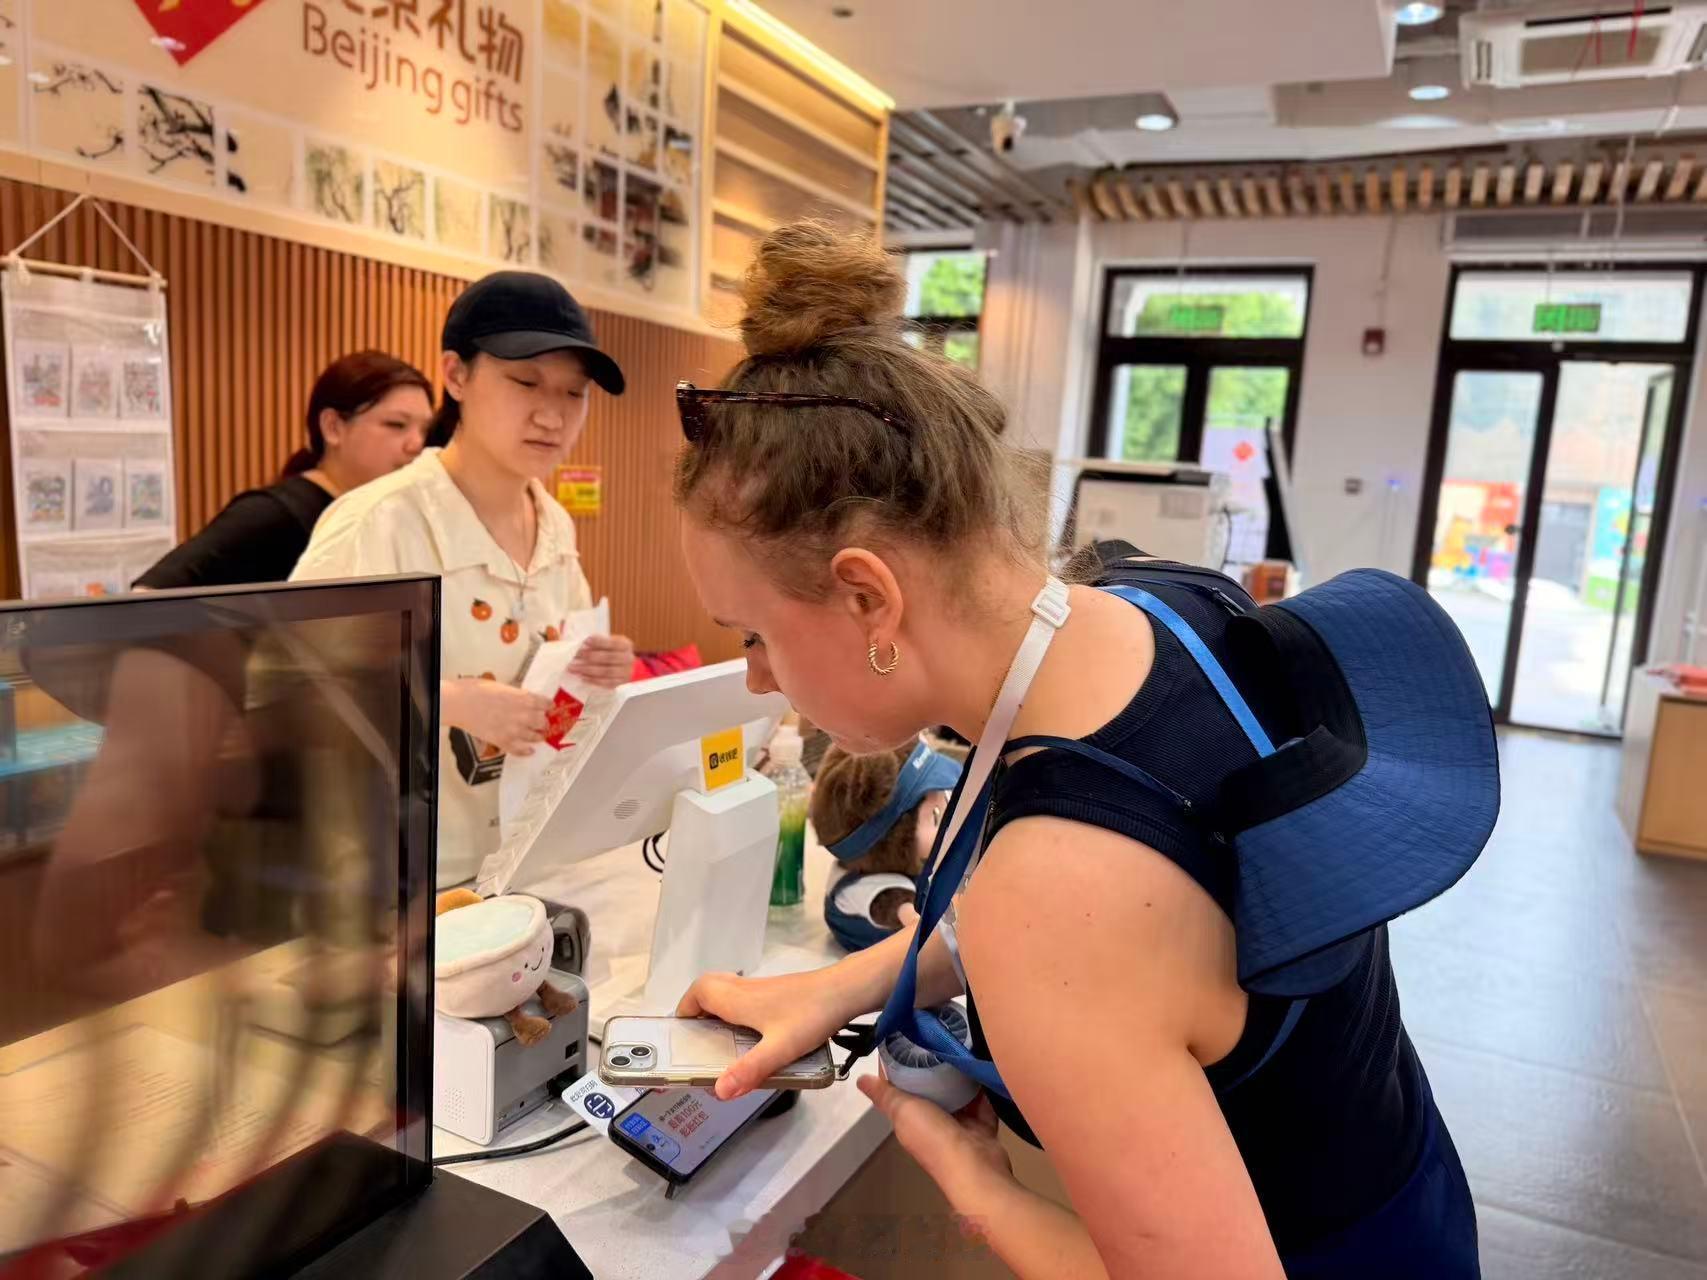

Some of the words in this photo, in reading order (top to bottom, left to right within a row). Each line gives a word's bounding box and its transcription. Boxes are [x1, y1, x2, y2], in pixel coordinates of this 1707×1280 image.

[303, 2, 443, 115] Beijing
[451, 76, 523, 133] gifts
[341, 0, 524, 84] 京礼物
